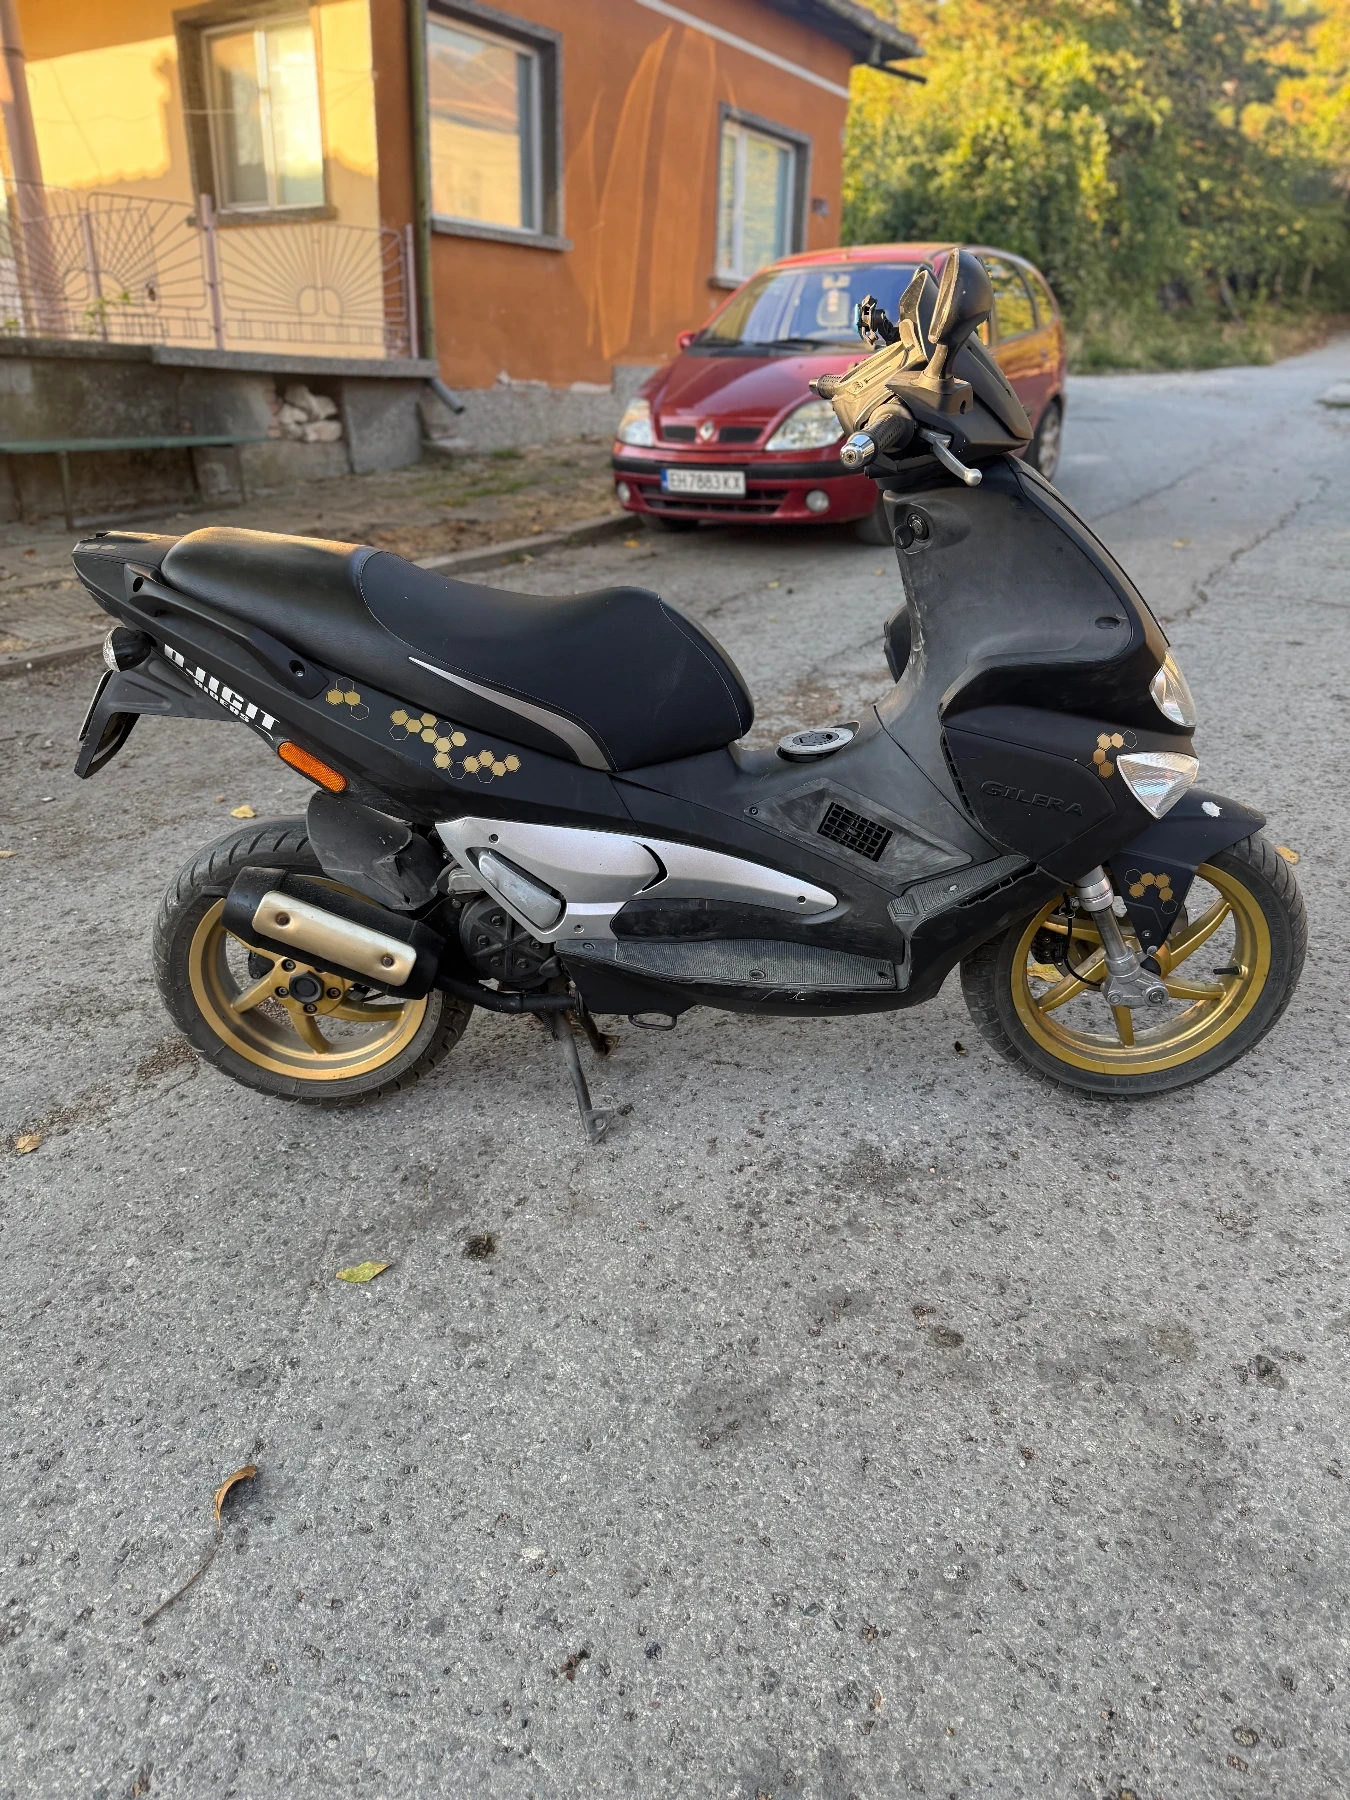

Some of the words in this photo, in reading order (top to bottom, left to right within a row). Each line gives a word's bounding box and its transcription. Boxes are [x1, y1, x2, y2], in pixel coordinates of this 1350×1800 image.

[164, 643, 280, 730] DJIGIT
[194, 679, 249, 723] RIDERS
[981, 780, 1084, 816] GILERA
